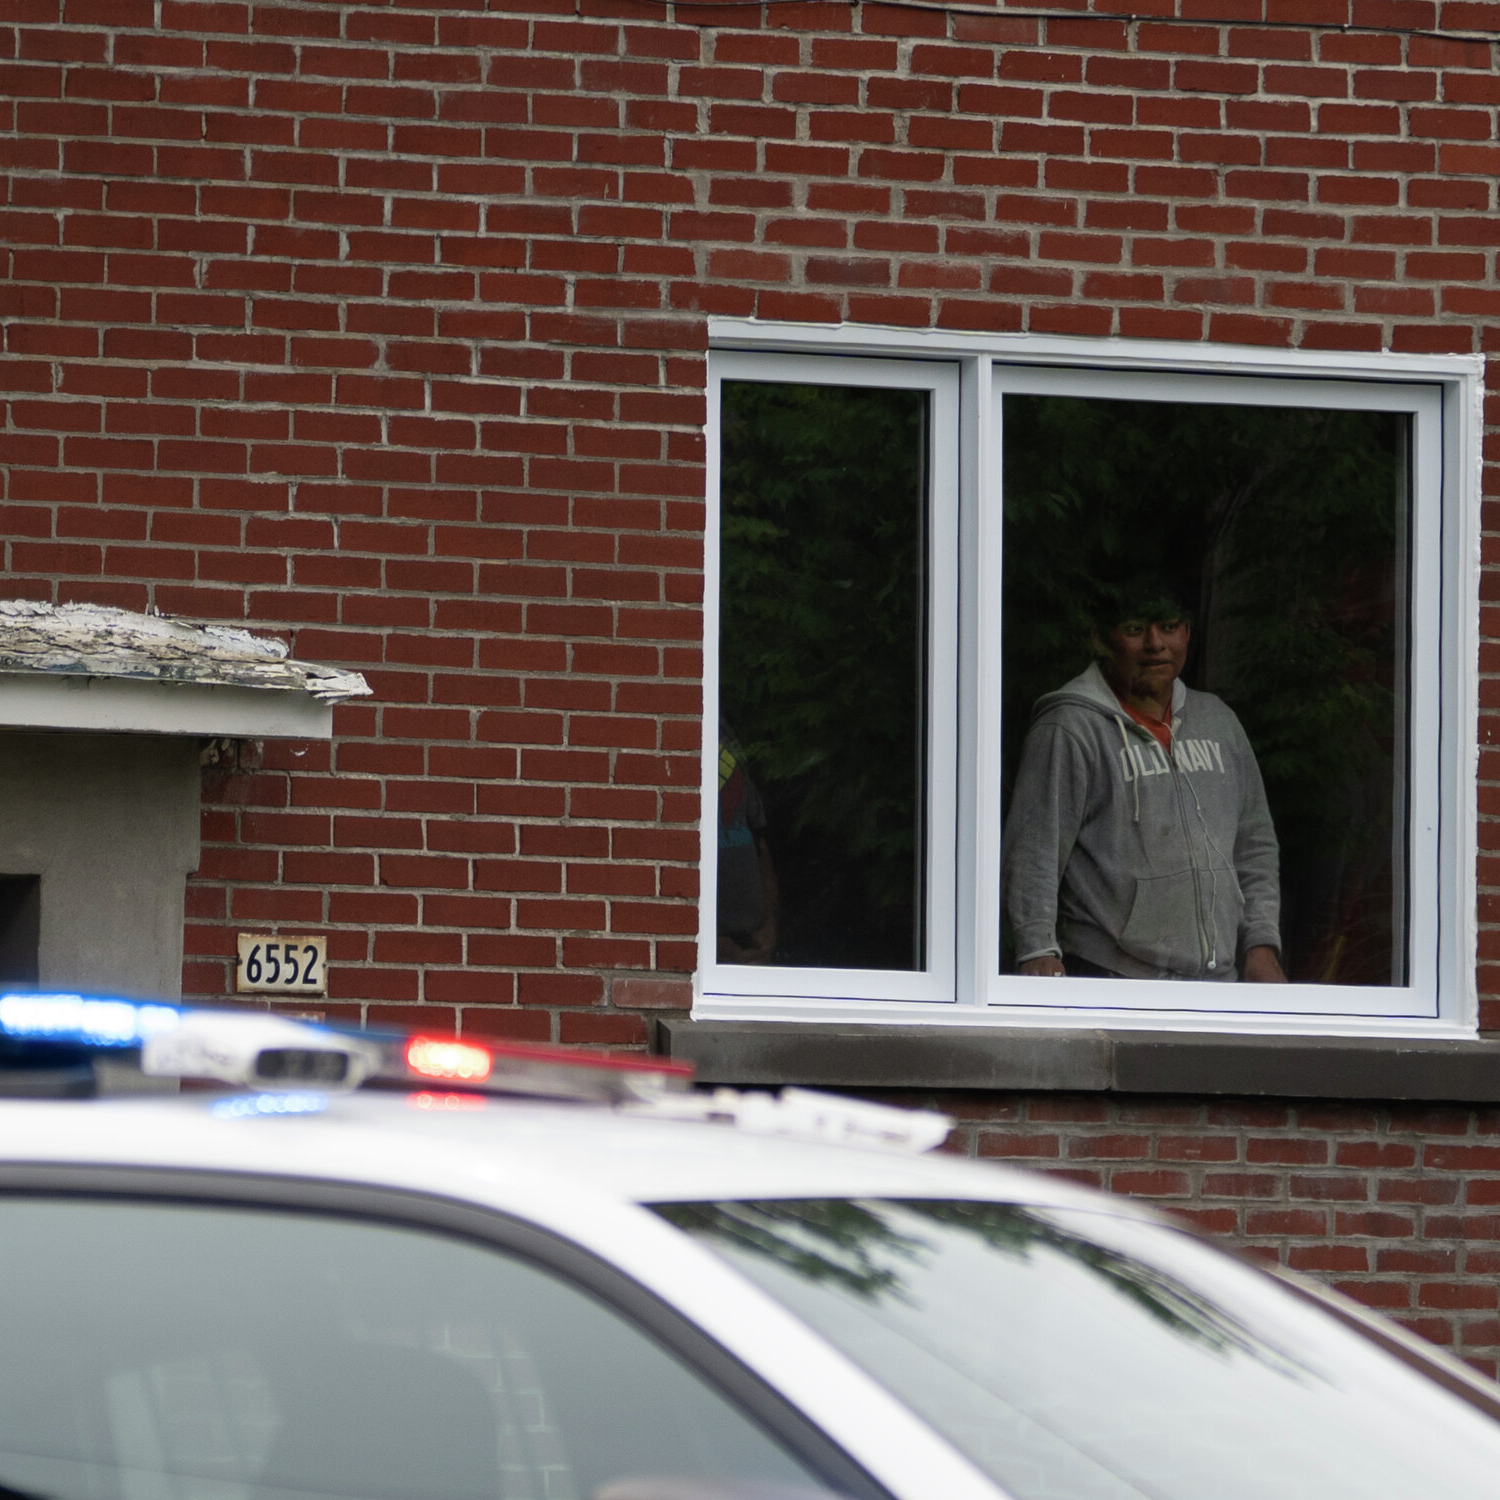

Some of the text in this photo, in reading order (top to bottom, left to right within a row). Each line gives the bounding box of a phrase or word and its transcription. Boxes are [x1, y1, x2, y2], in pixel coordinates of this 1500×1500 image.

[1120, 739, 1225, 782] OLD NAVY
[246, 943, 318, 985] 6552
